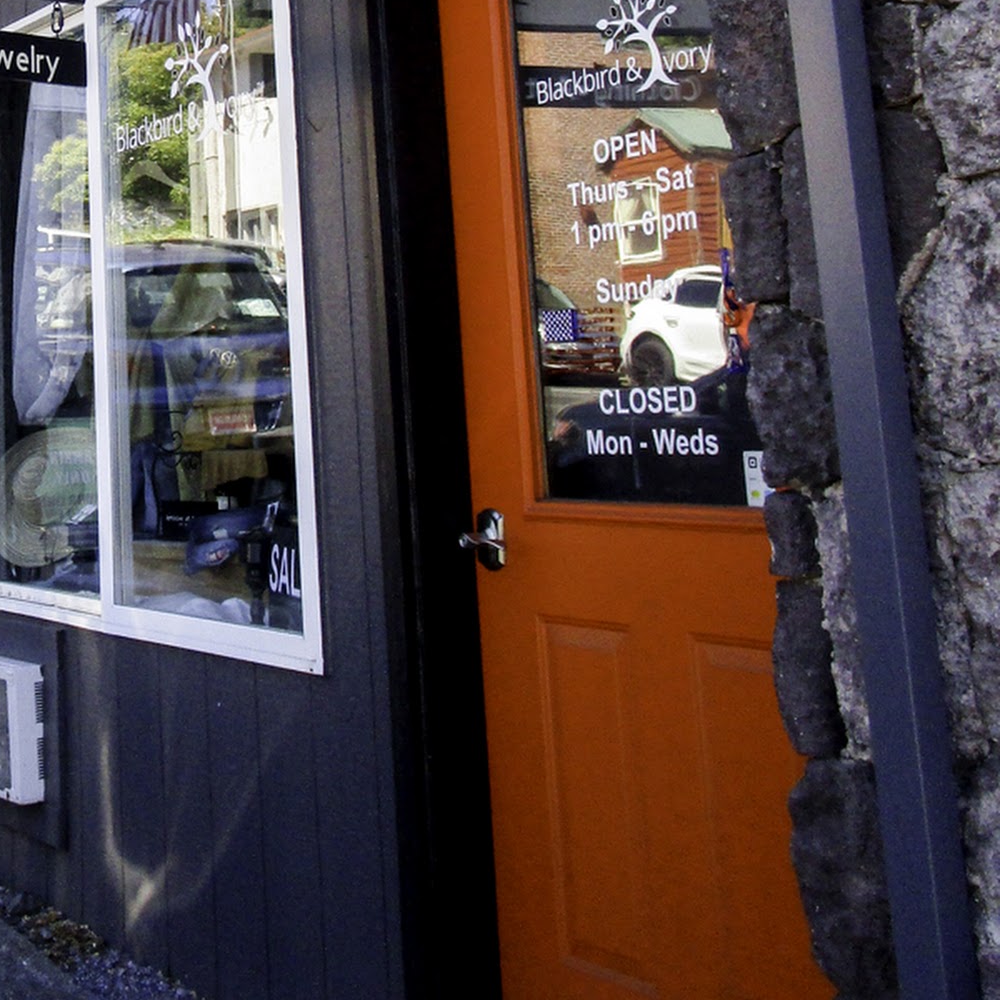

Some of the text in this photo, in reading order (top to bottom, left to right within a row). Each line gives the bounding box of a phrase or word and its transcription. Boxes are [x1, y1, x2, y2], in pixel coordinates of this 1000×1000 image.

[536, 60, 620, 105] Blackbird
[625, 56, 643, 82] &
[115, 104, 183, 152] Blackbird
[187, 101, 201, 132] &
[593, 128, 657, 164] OPEN
[567, 179, 628, 207] Thurs
[656, 163, 695, 193] Sat
[570, 221, 580, 244] 1
[588, 220, 619, 248] pm
[641, 210, 654, 236] 6
[662, 210, 698, 240] pm
[599, 386, 697, 415] CLOSED
[586, 429, 632, 455] Mon
[653, 428, 719, 456] Weds
